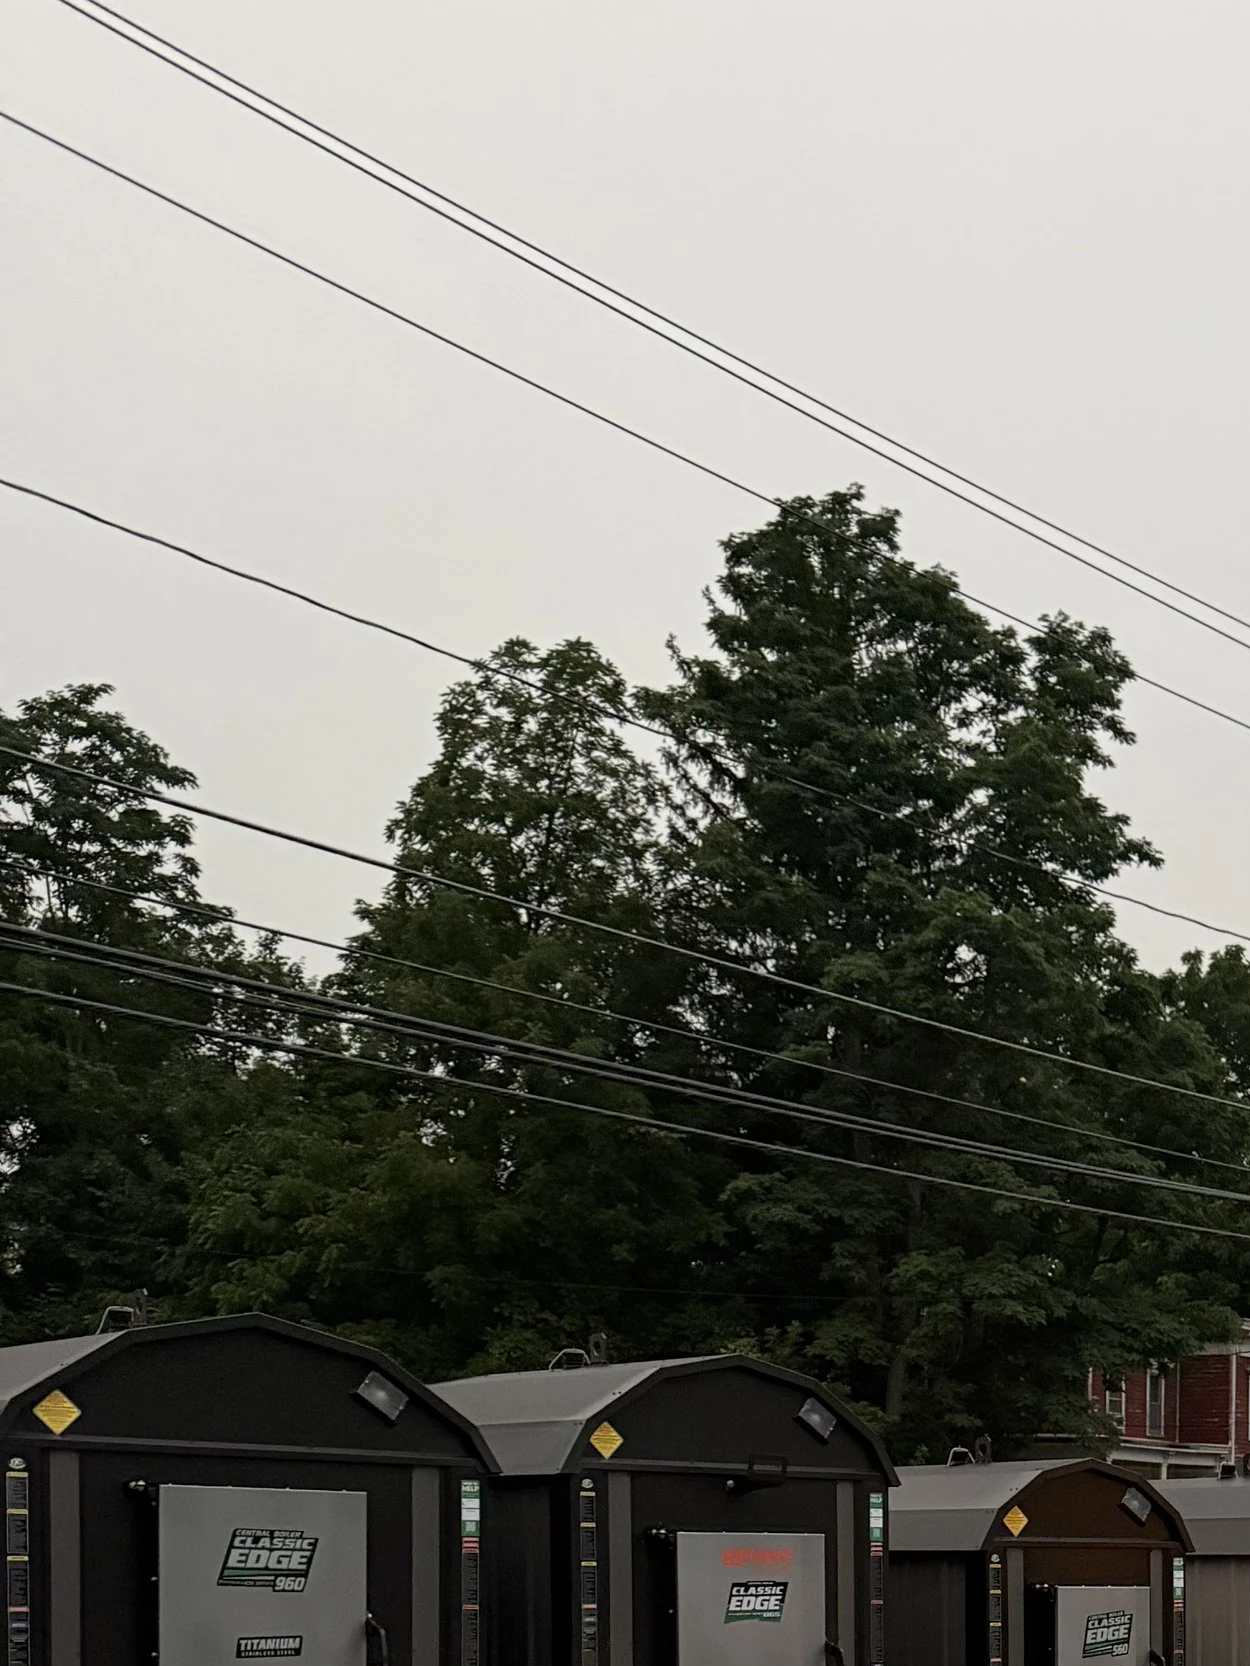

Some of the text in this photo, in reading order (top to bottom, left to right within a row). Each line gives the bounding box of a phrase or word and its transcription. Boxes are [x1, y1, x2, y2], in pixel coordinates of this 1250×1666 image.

[233, 1537, 314, 1549] CLASSIC
[226, 1549, 311, 1569] EDGE
[274, 1577, 305, 1590] 960
[732, 1586, 784, 1595] CLASSIC
[729, 1595, 782, 1611] EDGE
[1088, 1615, 1131, 1629] CLASSIC
[1086, 1624, 1130, 1644] EDGE
[239, 1638, 300, 1650] TITANIUM
